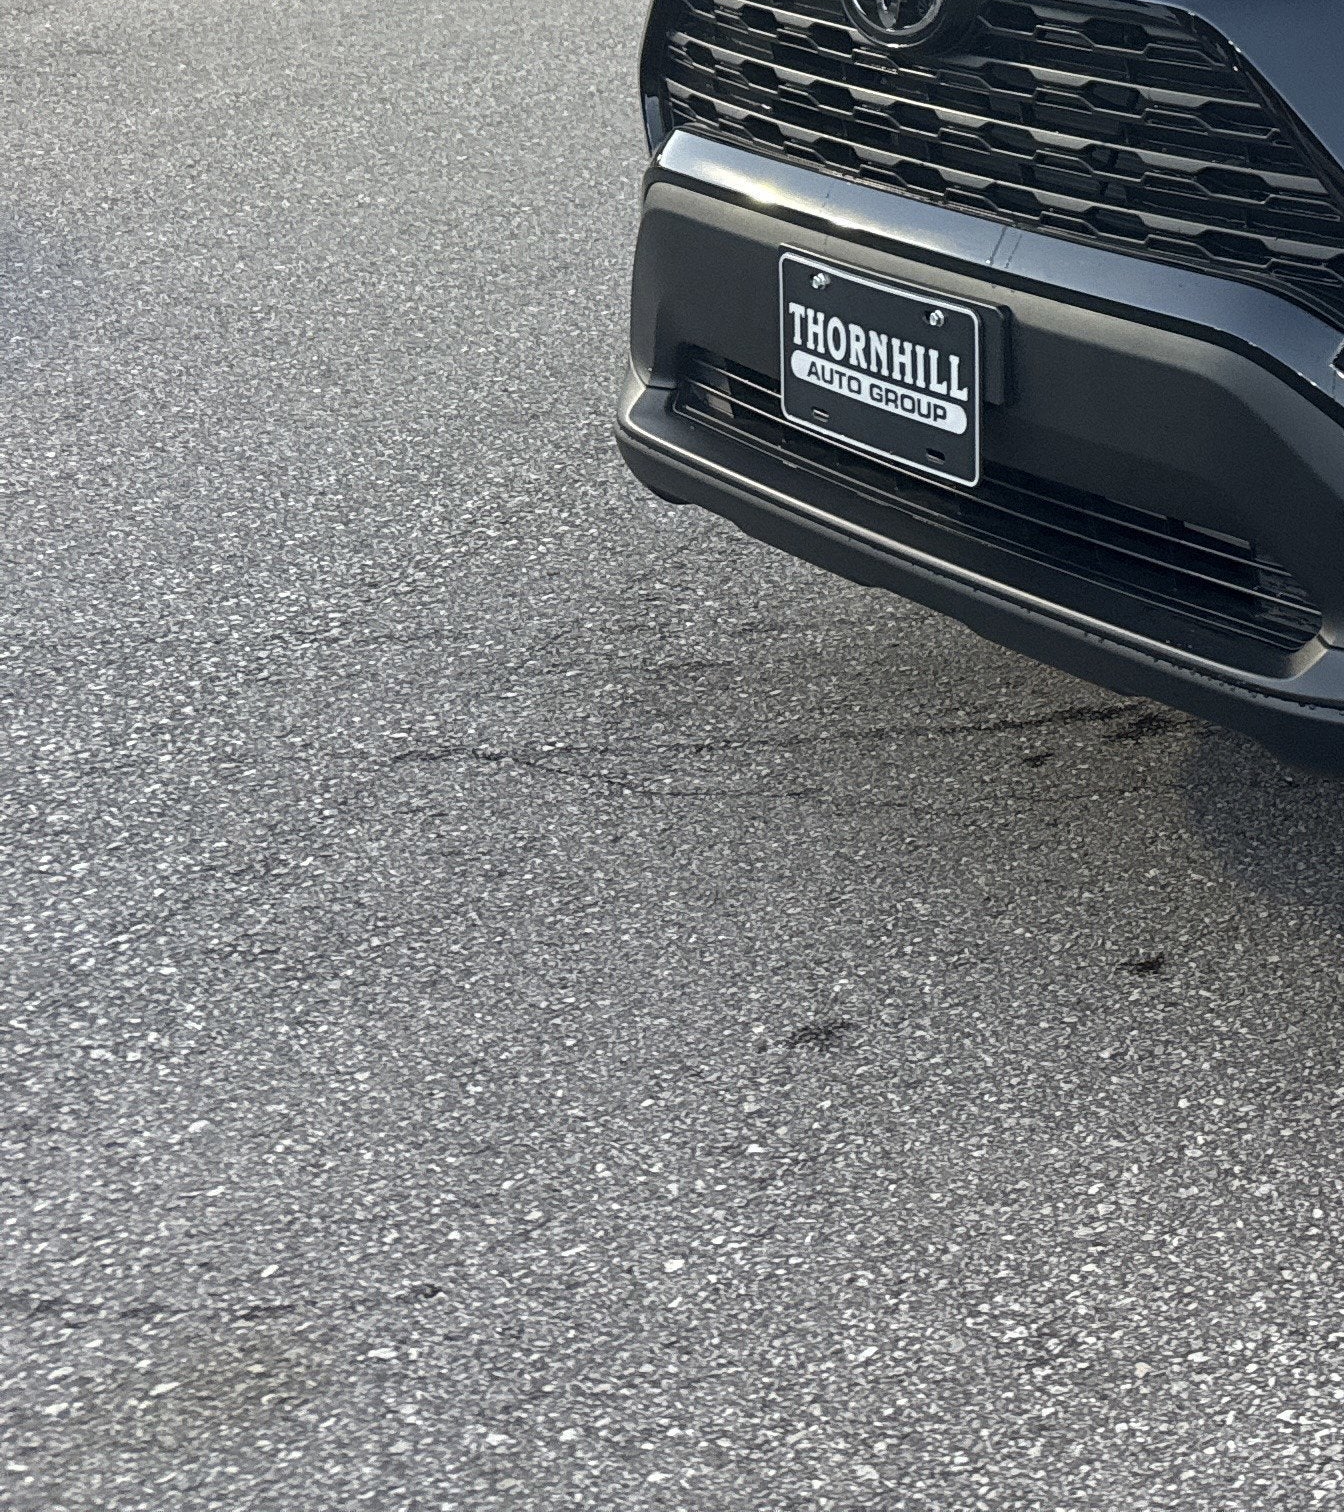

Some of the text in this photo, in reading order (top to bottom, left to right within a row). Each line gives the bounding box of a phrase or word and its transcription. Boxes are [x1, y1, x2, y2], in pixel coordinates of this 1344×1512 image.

[788, 301, 969, 402] THORNHILL
[806, 361, 947, 423] AUTO GROUP
